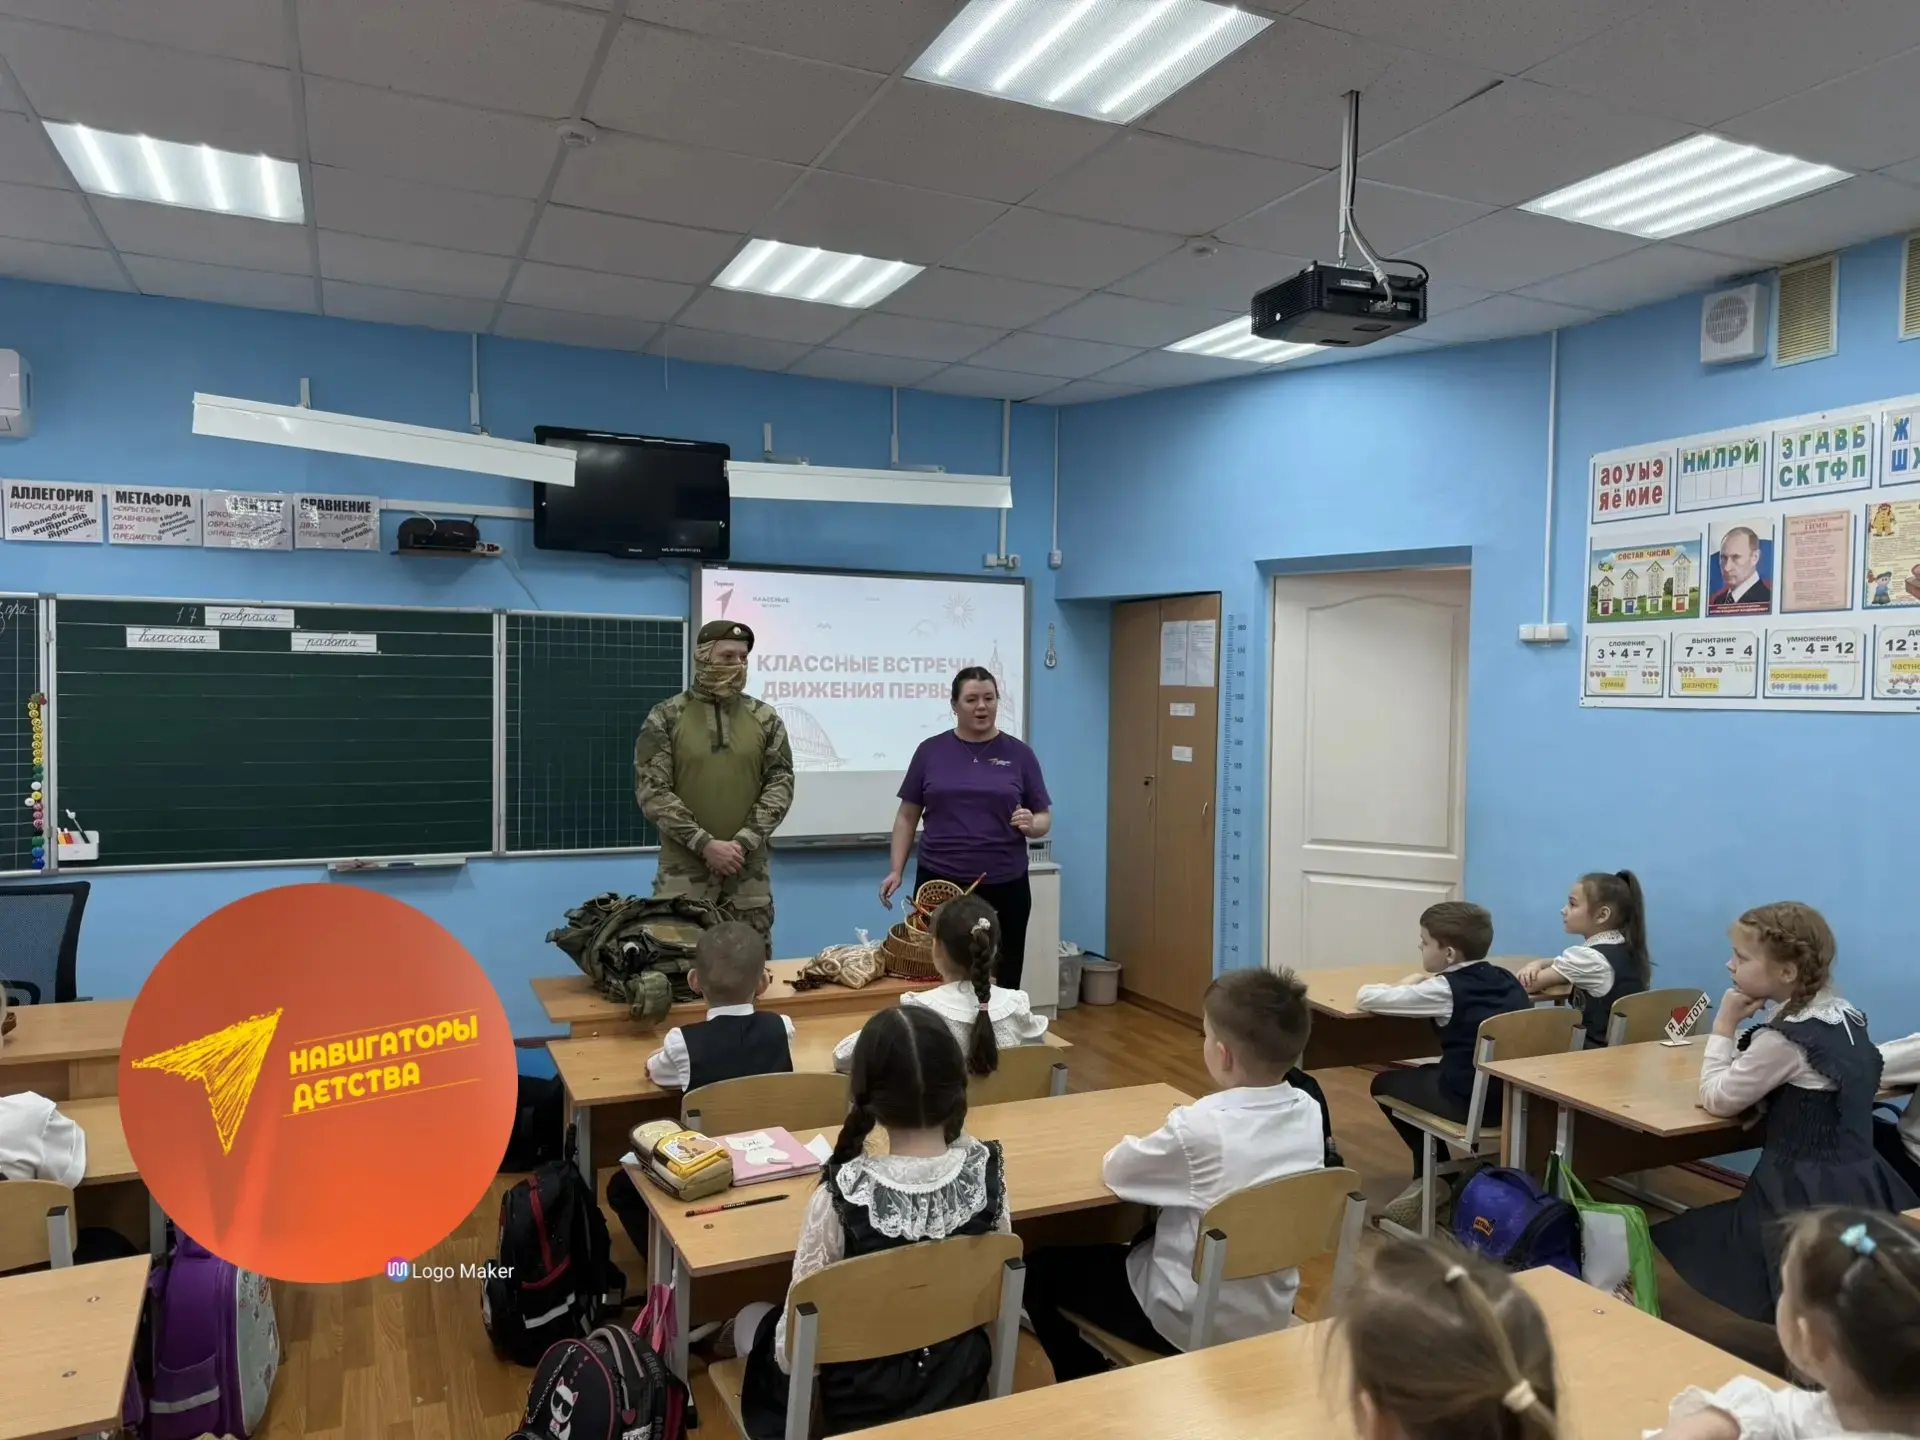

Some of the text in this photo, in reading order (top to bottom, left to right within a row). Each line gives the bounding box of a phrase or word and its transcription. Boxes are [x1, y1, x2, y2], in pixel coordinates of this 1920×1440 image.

[11, 485, 94, 503] АЛЛЕГОРИЯ
[115, 490, 191, 508] МЕТАФОРА
[9, 500, 86, 513] ИНОСКАЗАНИЕ
[300, 498, 371, 513] СРАВНЕНИЕ
[33, 512, 88, 536] хитрость
[48, 517, 97, 539] трусость
[1646, 548, 1671, 558] ЧИСЛА
[138, 628, 358, 651] Классная работа
[1608, 639, 1646, 648] сложение
[1691, 636, 1737, 644] вычитание
[1786, 635, 1838, 645] умножение
[1885, 639, 1907, 652] 12
[1597, 648, 1605, 659] 3
[1620, 648, 1629, 659] 4
[1645, 648, 1654, 659] 7
[1685, 646, 1694, 657] 7
[1707, 646, 1716, 657] 3
[1743, 645, 1753, 657] 4
[1773, 643, 1782, 655] 3
[1805, 642, 1815, 654] 4
[1835, 642, 1854, 654] 12
[757, 654, 975, 674] КЛАССНЫЕ ВСТРЕЧИ
[761, 681, 953, 701] ДВИЖЕНИЯ ПЕРВЫ
[1681, 680, 1718, 691] разность
[1675, 996, 1708, 1037] ЧИСТОТУ
[1668, 1022, 1676, 1033] Я
